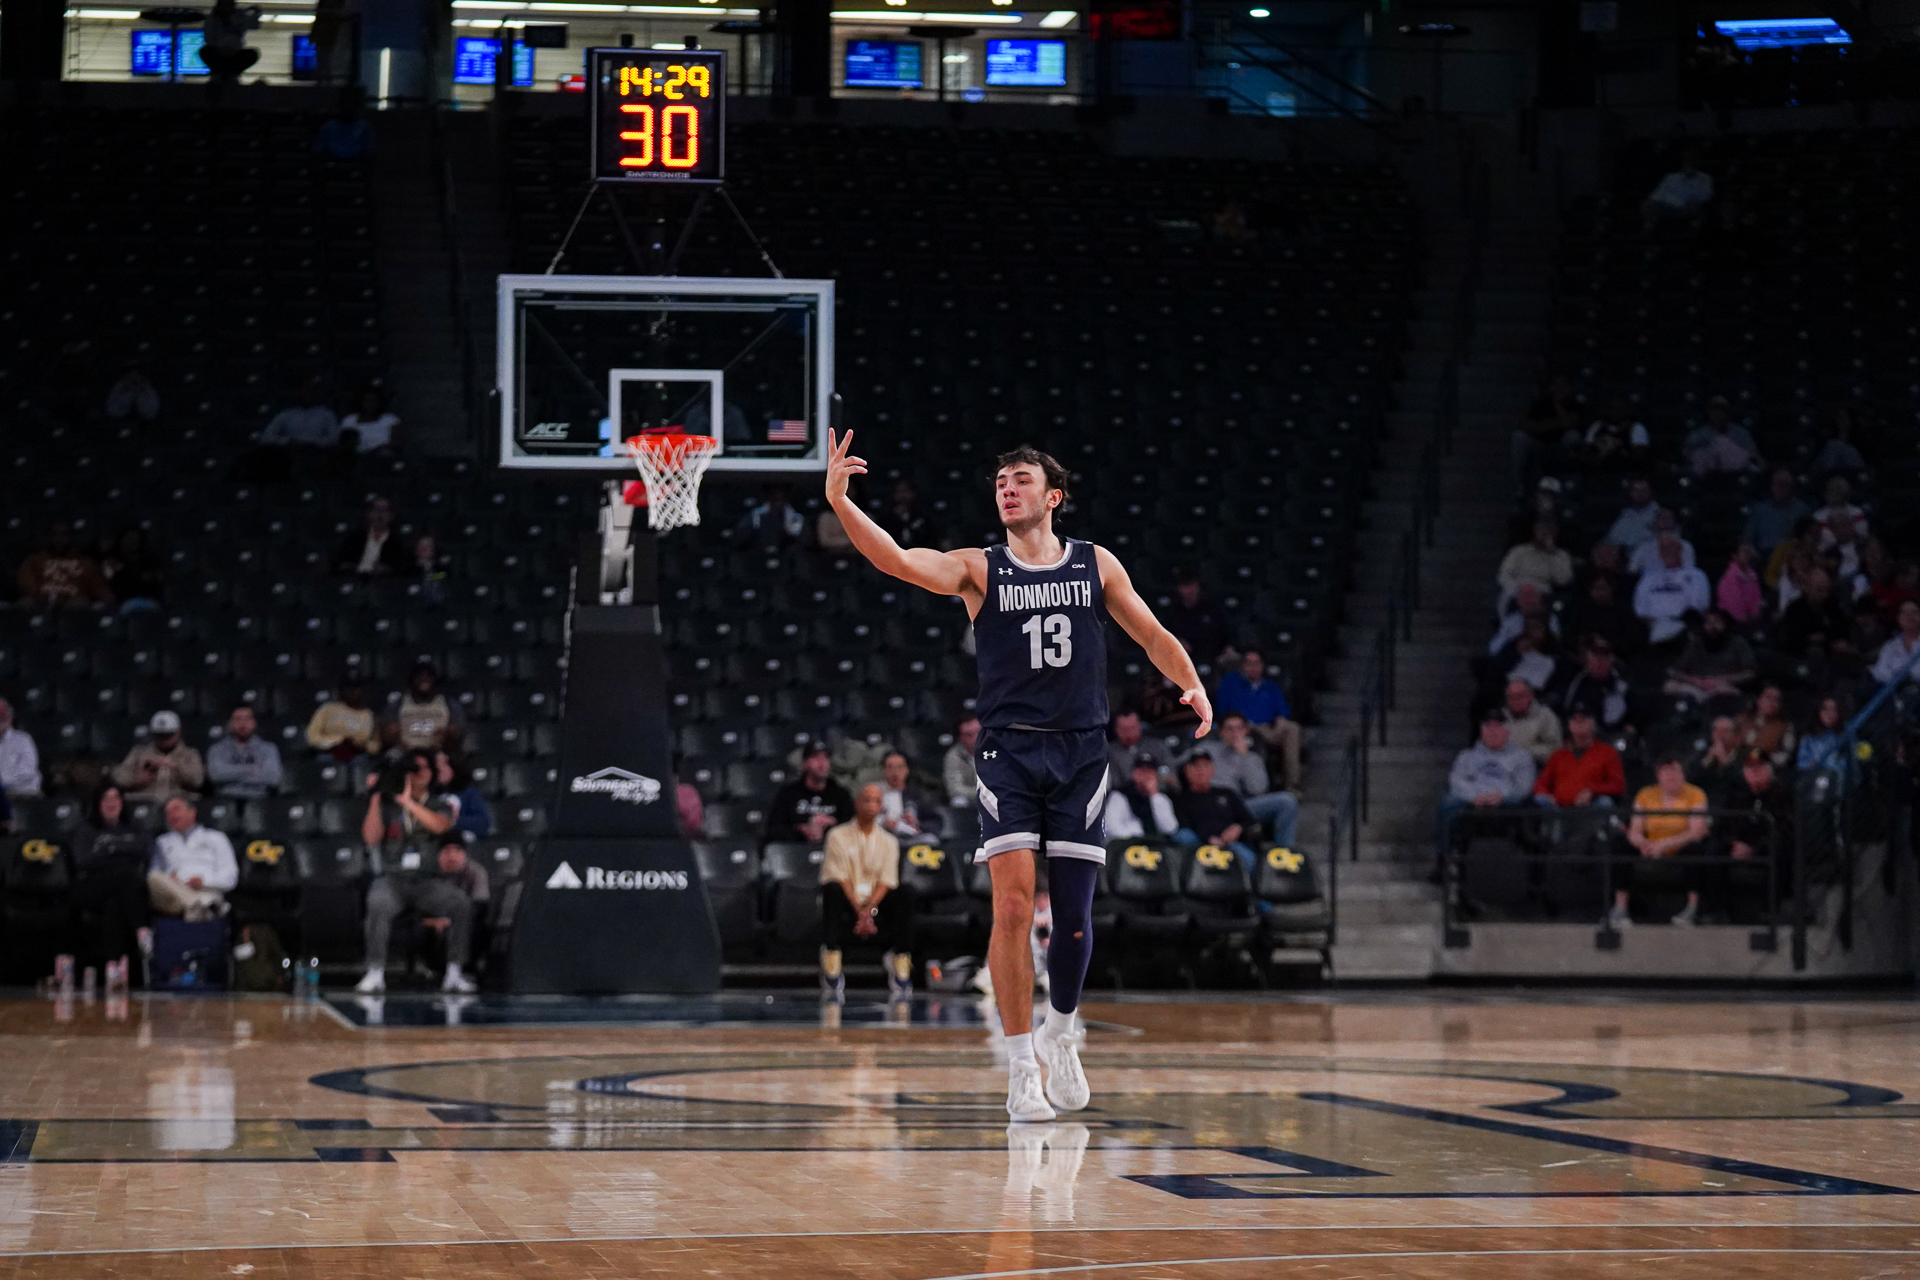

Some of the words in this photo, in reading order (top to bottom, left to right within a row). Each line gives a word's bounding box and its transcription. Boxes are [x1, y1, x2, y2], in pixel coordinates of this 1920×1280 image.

[620, 65, 710, 100] 14:29
[620, 104, 699, 168] 30
[525, 422, 571, 440] ACC
[998, 581, 1091, 612] MONMOUTH
[1022, 613, 1072, 669] 13
